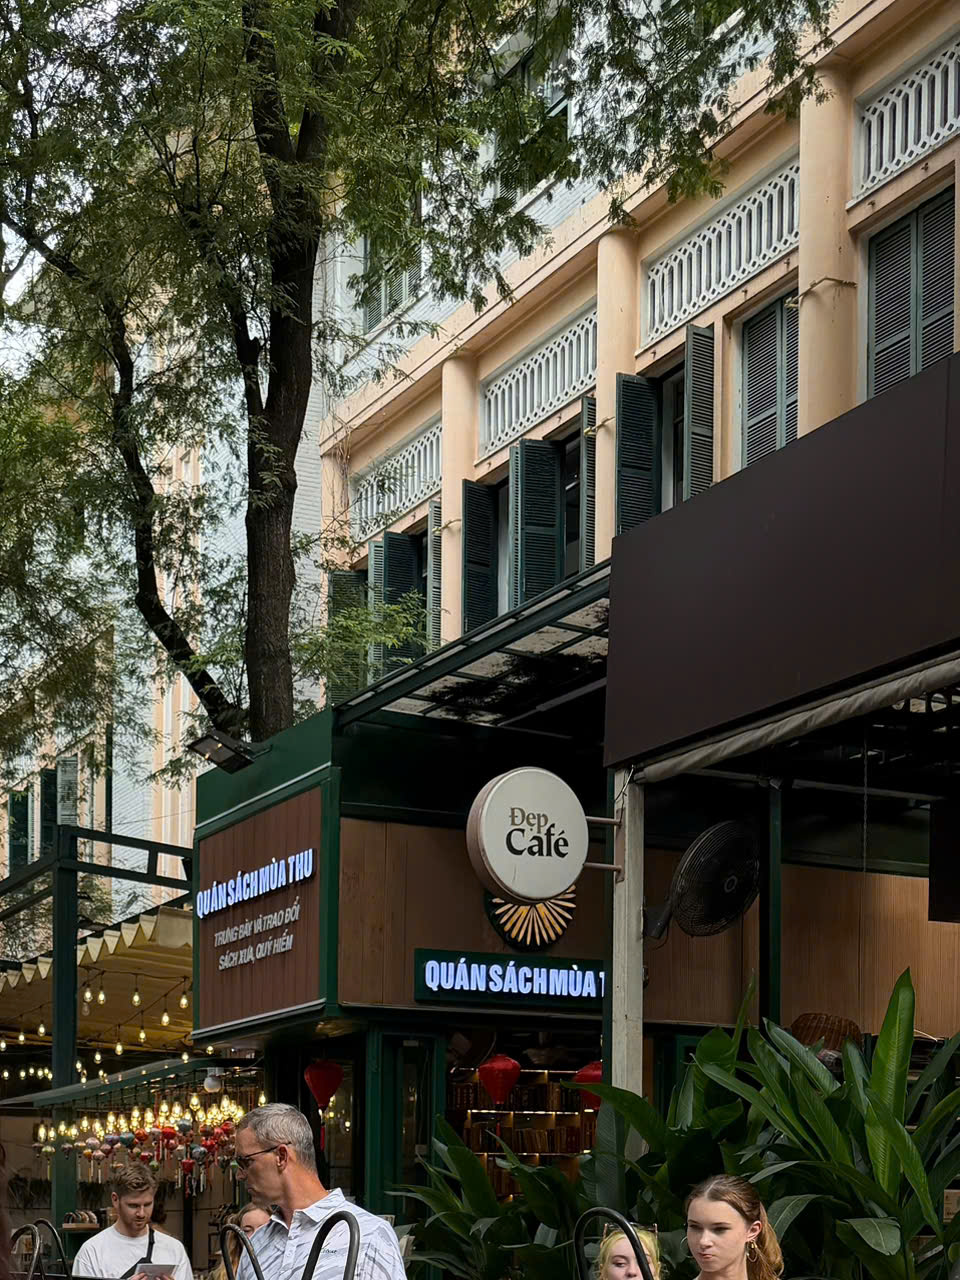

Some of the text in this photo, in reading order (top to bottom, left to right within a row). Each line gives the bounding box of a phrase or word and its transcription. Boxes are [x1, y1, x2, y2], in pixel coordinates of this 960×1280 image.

[509, 807, 548, 833] Đẹp
[506, 823, 569, 858] Café
[196, 848, 313, 919] QUÁN SÁCH MÙA THU
[262, 910, 284, 931] TRAO
[219, 950, 239, 970] SÁCH
[256, 936, 273, 959] QUÝ
[272, 929, 294, 954] HIẾM
[425, 957, 487, 991] QUÁN
[489, 960, 548, 994] SÁCH
[549, 964, 597, 997] MÙA
